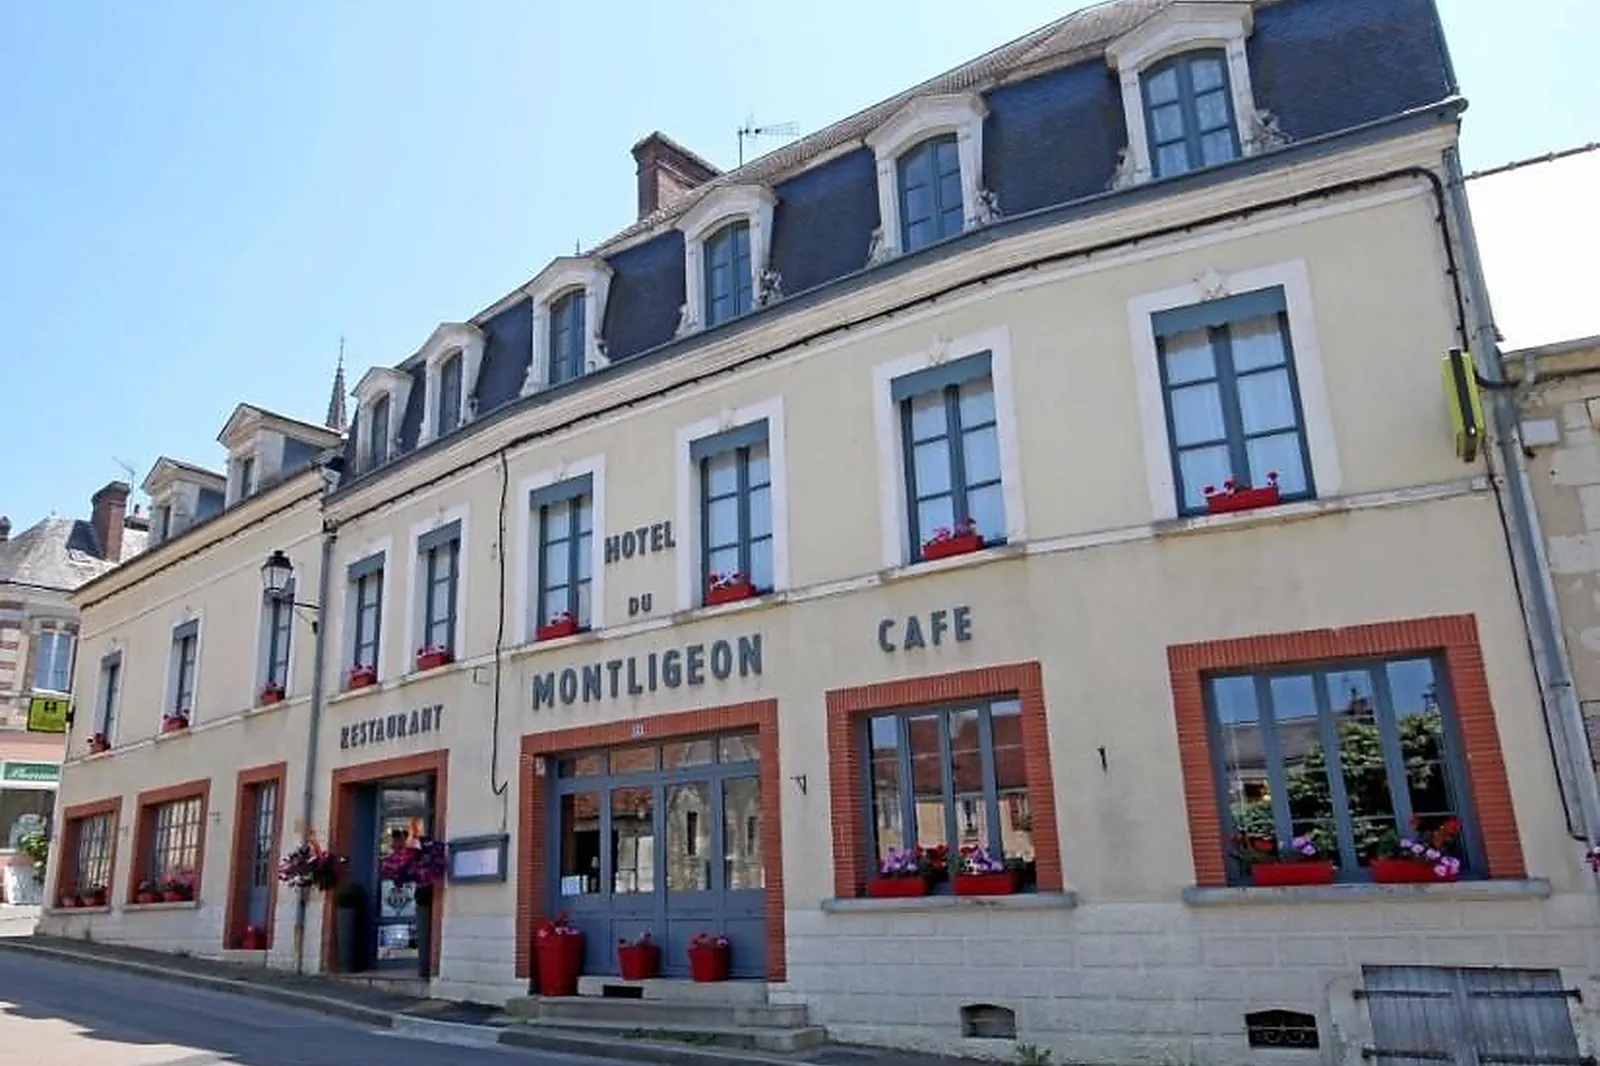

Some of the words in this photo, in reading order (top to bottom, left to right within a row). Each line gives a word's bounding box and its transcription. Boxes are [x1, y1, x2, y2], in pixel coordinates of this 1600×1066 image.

[604, 520, 676, 564] HOTEL
[628, 593, 652, 617] DU
[878, 605, 972, 652] CAFE
[532, 634, 762, 710] MONTLIGEON
[340, 704, 443, 749] RESTAURANT
